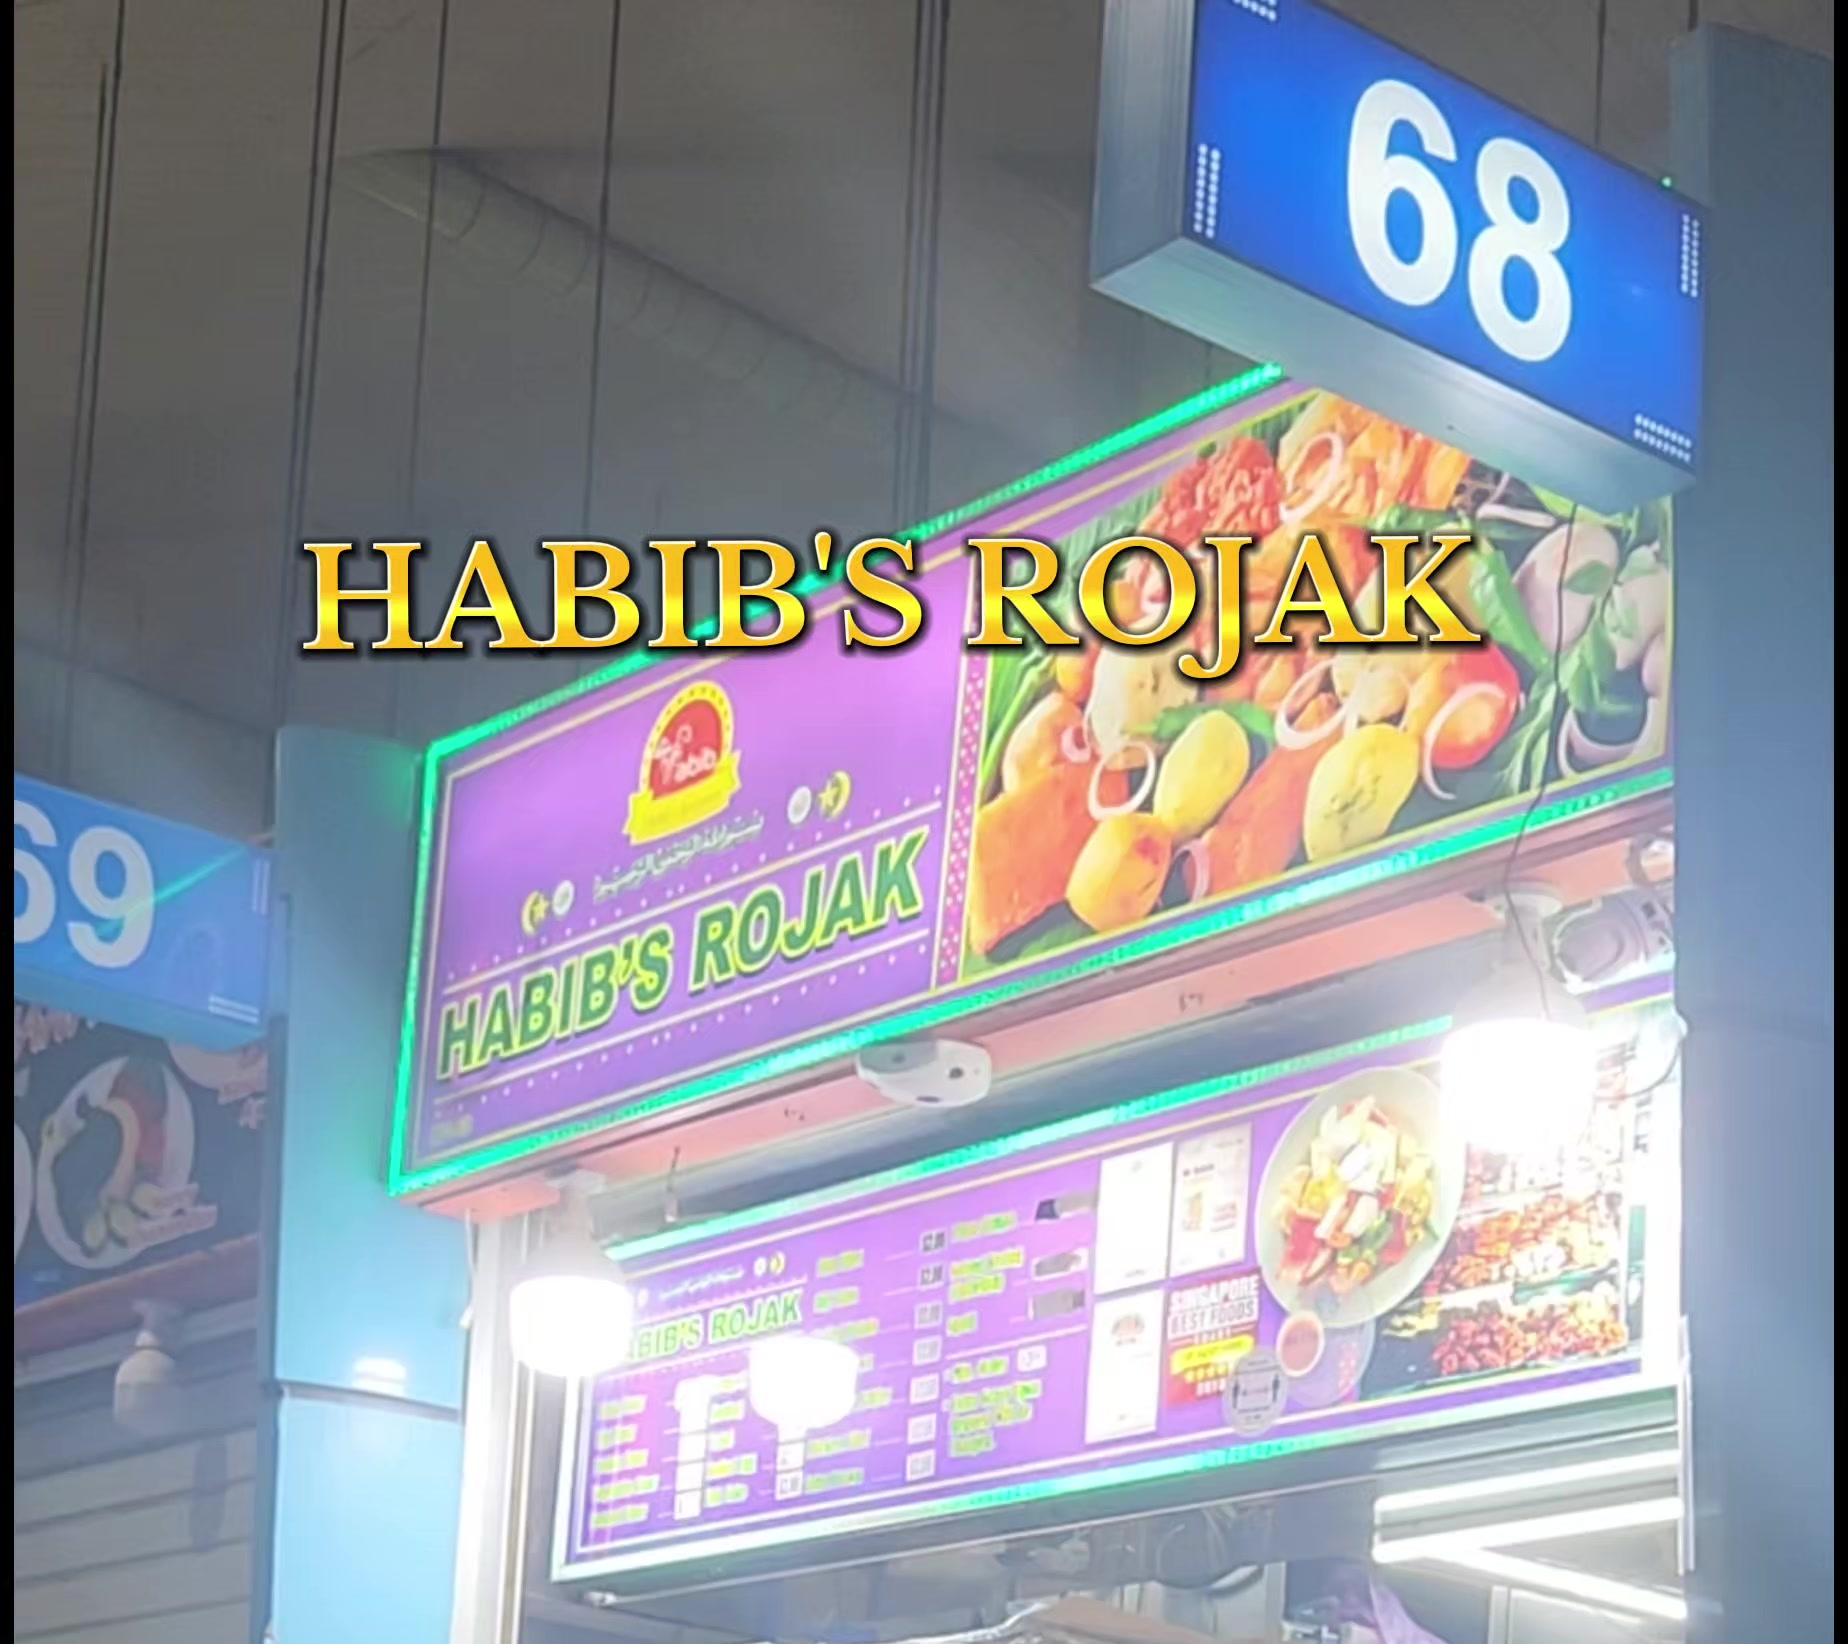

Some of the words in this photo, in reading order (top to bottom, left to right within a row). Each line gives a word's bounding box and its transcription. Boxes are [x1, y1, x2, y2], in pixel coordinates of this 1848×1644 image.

[1348, 80, 1571, 362] 68
[435, 921, 673, 1081] HABIB'S
[688, 824, 931, 993] ROJAK
[631, 1312, 704, 1363] BIB'S
[708, 1287, 803, 1345] ROJAK
